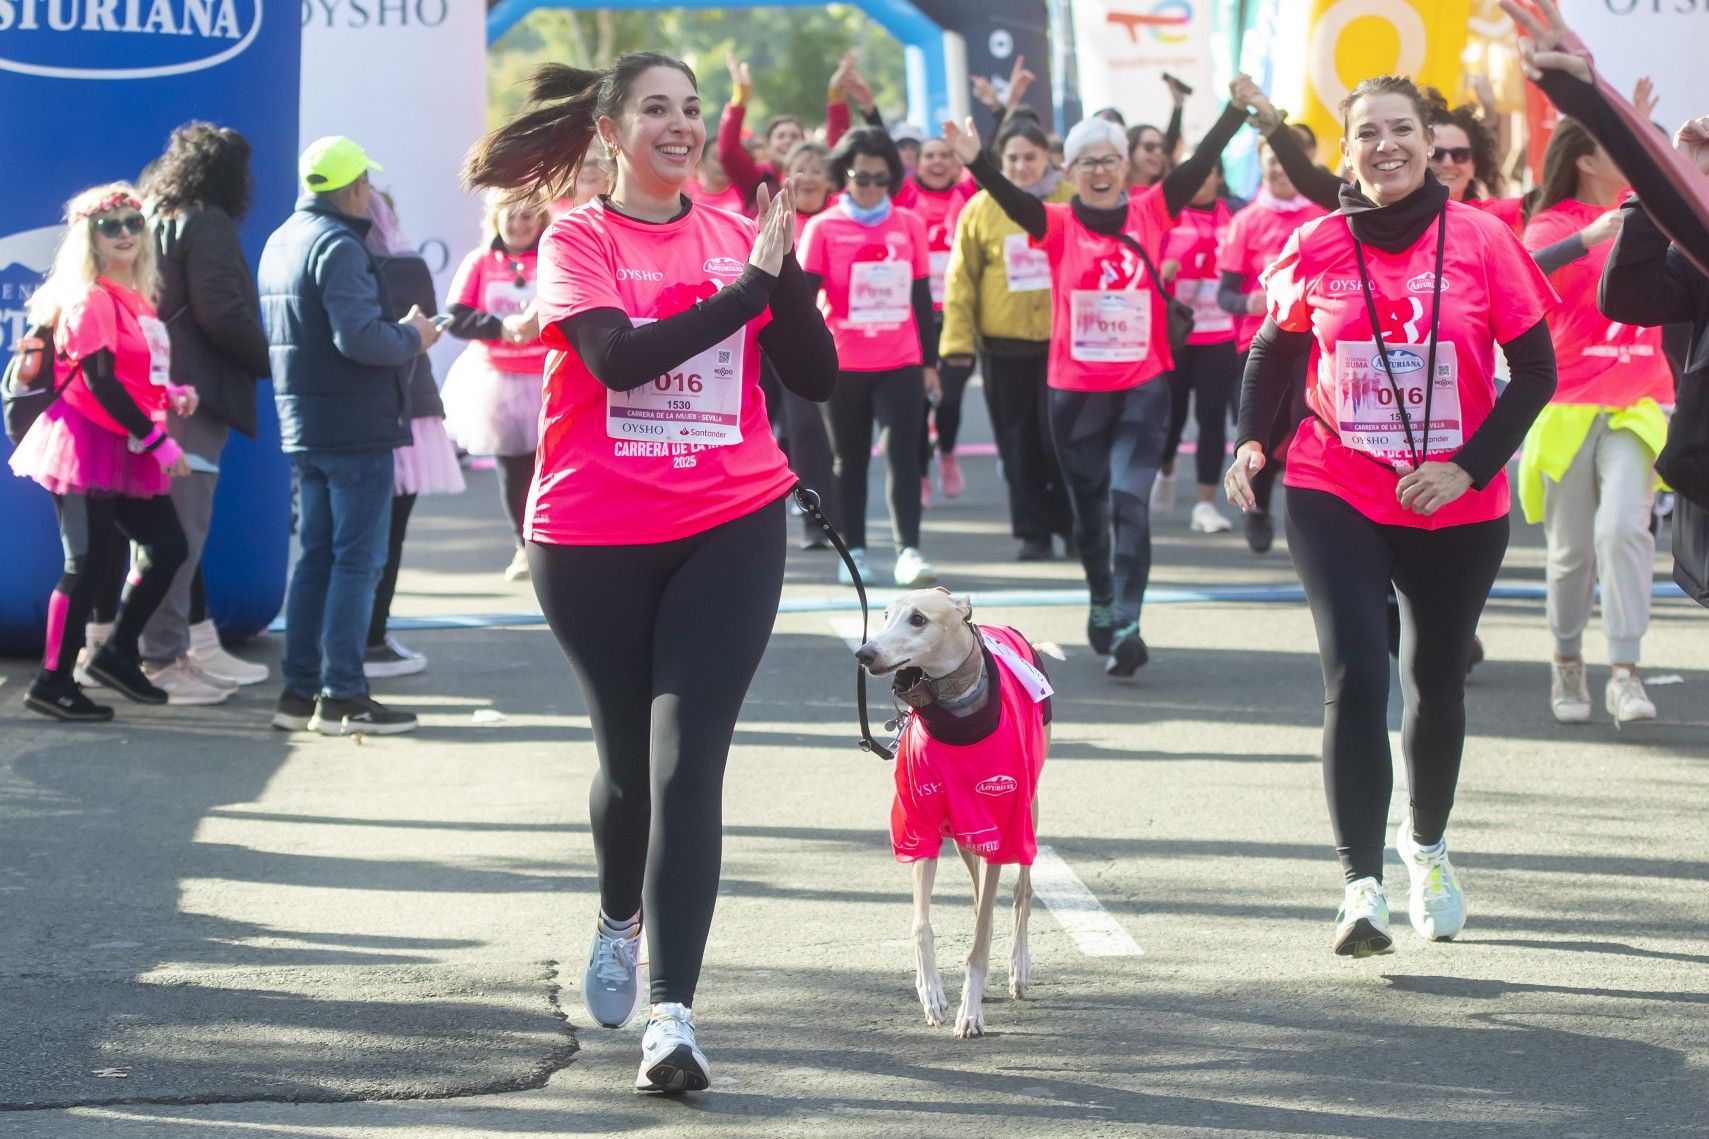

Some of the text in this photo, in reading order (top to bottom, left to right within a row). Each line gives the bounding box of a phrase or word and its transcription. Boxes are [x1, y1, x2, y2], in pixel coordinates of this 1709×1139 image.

[616, 268, 663, 281] OYSHO
[1098, 321, 1127, 332] 016
[1346, 361, 1368, 369] SUMA
[655, 372, 703, 394] 016
[1378, 387, 1423, 405] 016
[667, 400, 691, 410] 1530
[627, 410, 655, 418] CARRERA
[1390, 412, 1412, 421] 159
[623, 423, 664, 435] OYSHO
[690, 428, 726, 439] Santander
[1352, 436, 1389, 444] OYSHO
[614, 441, 669, 457] CARRERA
[674, 455, 696, 469] 2025
